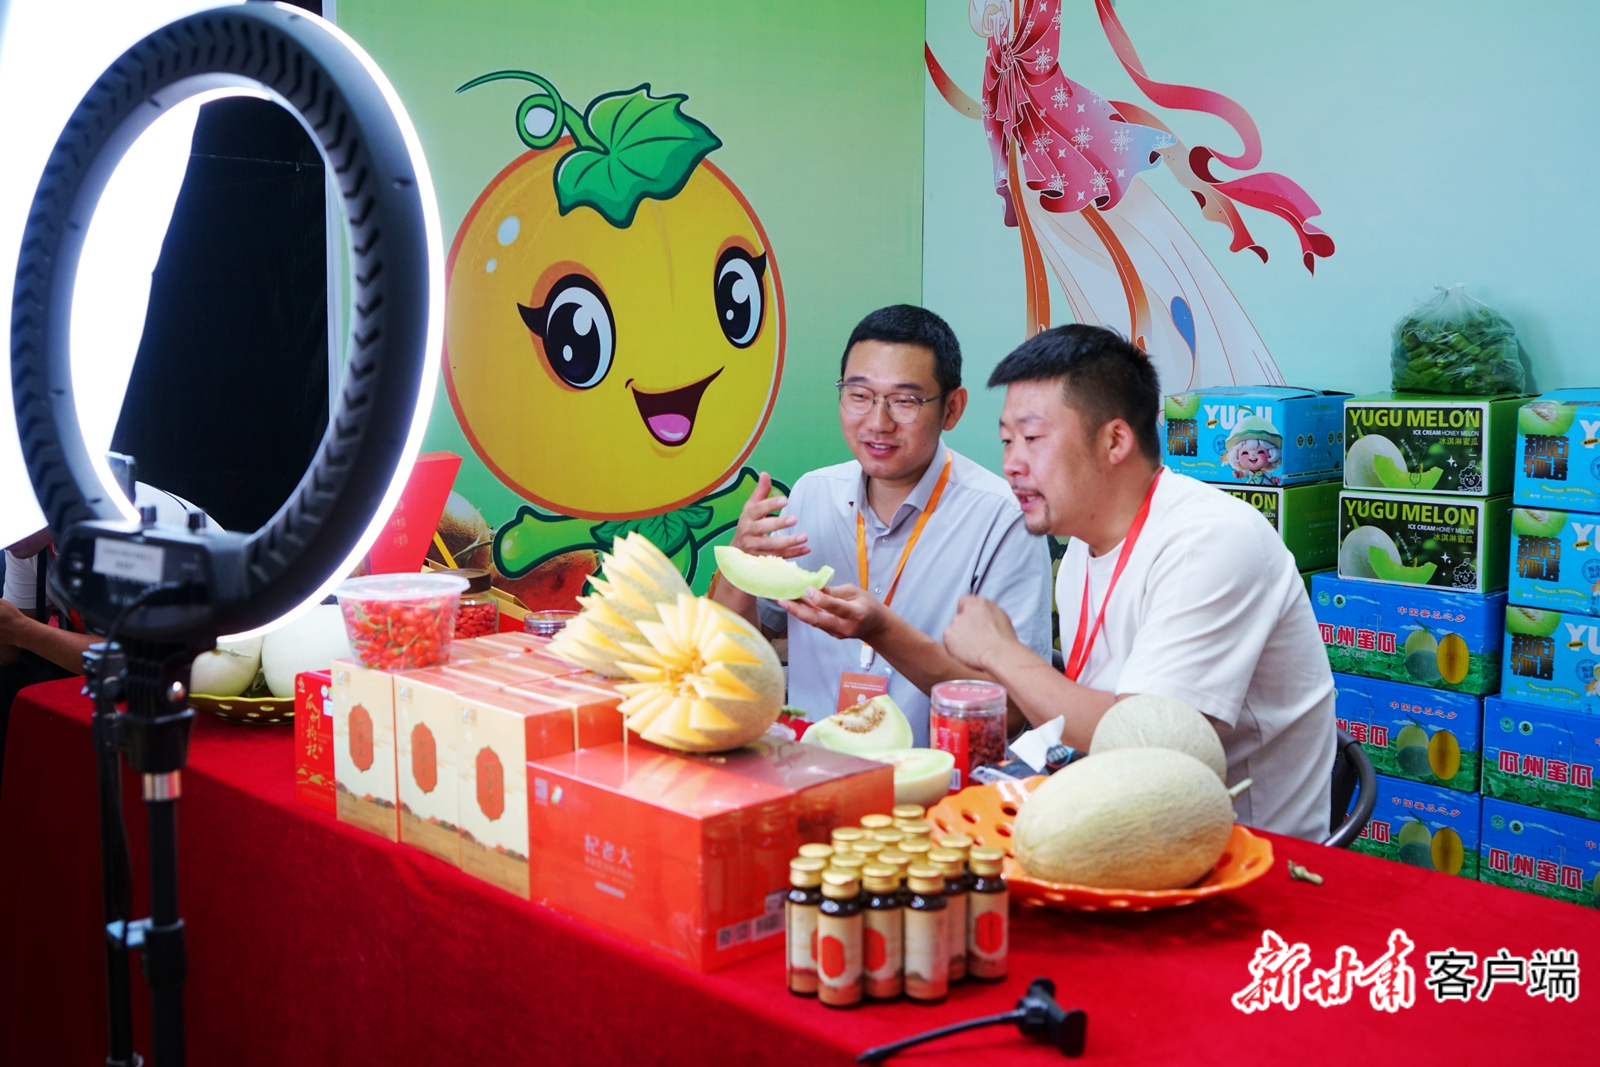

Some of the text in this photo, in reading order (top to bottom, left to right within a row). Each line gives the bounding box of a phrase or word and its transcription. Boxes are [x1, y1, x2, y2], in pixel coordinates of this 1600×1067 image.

[1349, 409, 1403, 427] YUGU
[1406, 409, 1480, 428] MELON
[1438, 437, 1479, 446] 冰淇淋蜜瓜
[1344, 499, 1398, 519] YUGU
[1401, 503, 1476, 526] MELON
[1407, 523, 1475, 535] ICE CREAM HONEY MELON
[1432, 533, 1474, 544] 冰淇淋蜜瓜
[1317, 622, 1398, 654] 瓜州蜜瓜
[1498, 749, 1594, 789] 瓜州蜜瓜
[1488, 847, 1584, 891] 瓜州蜜瓜
